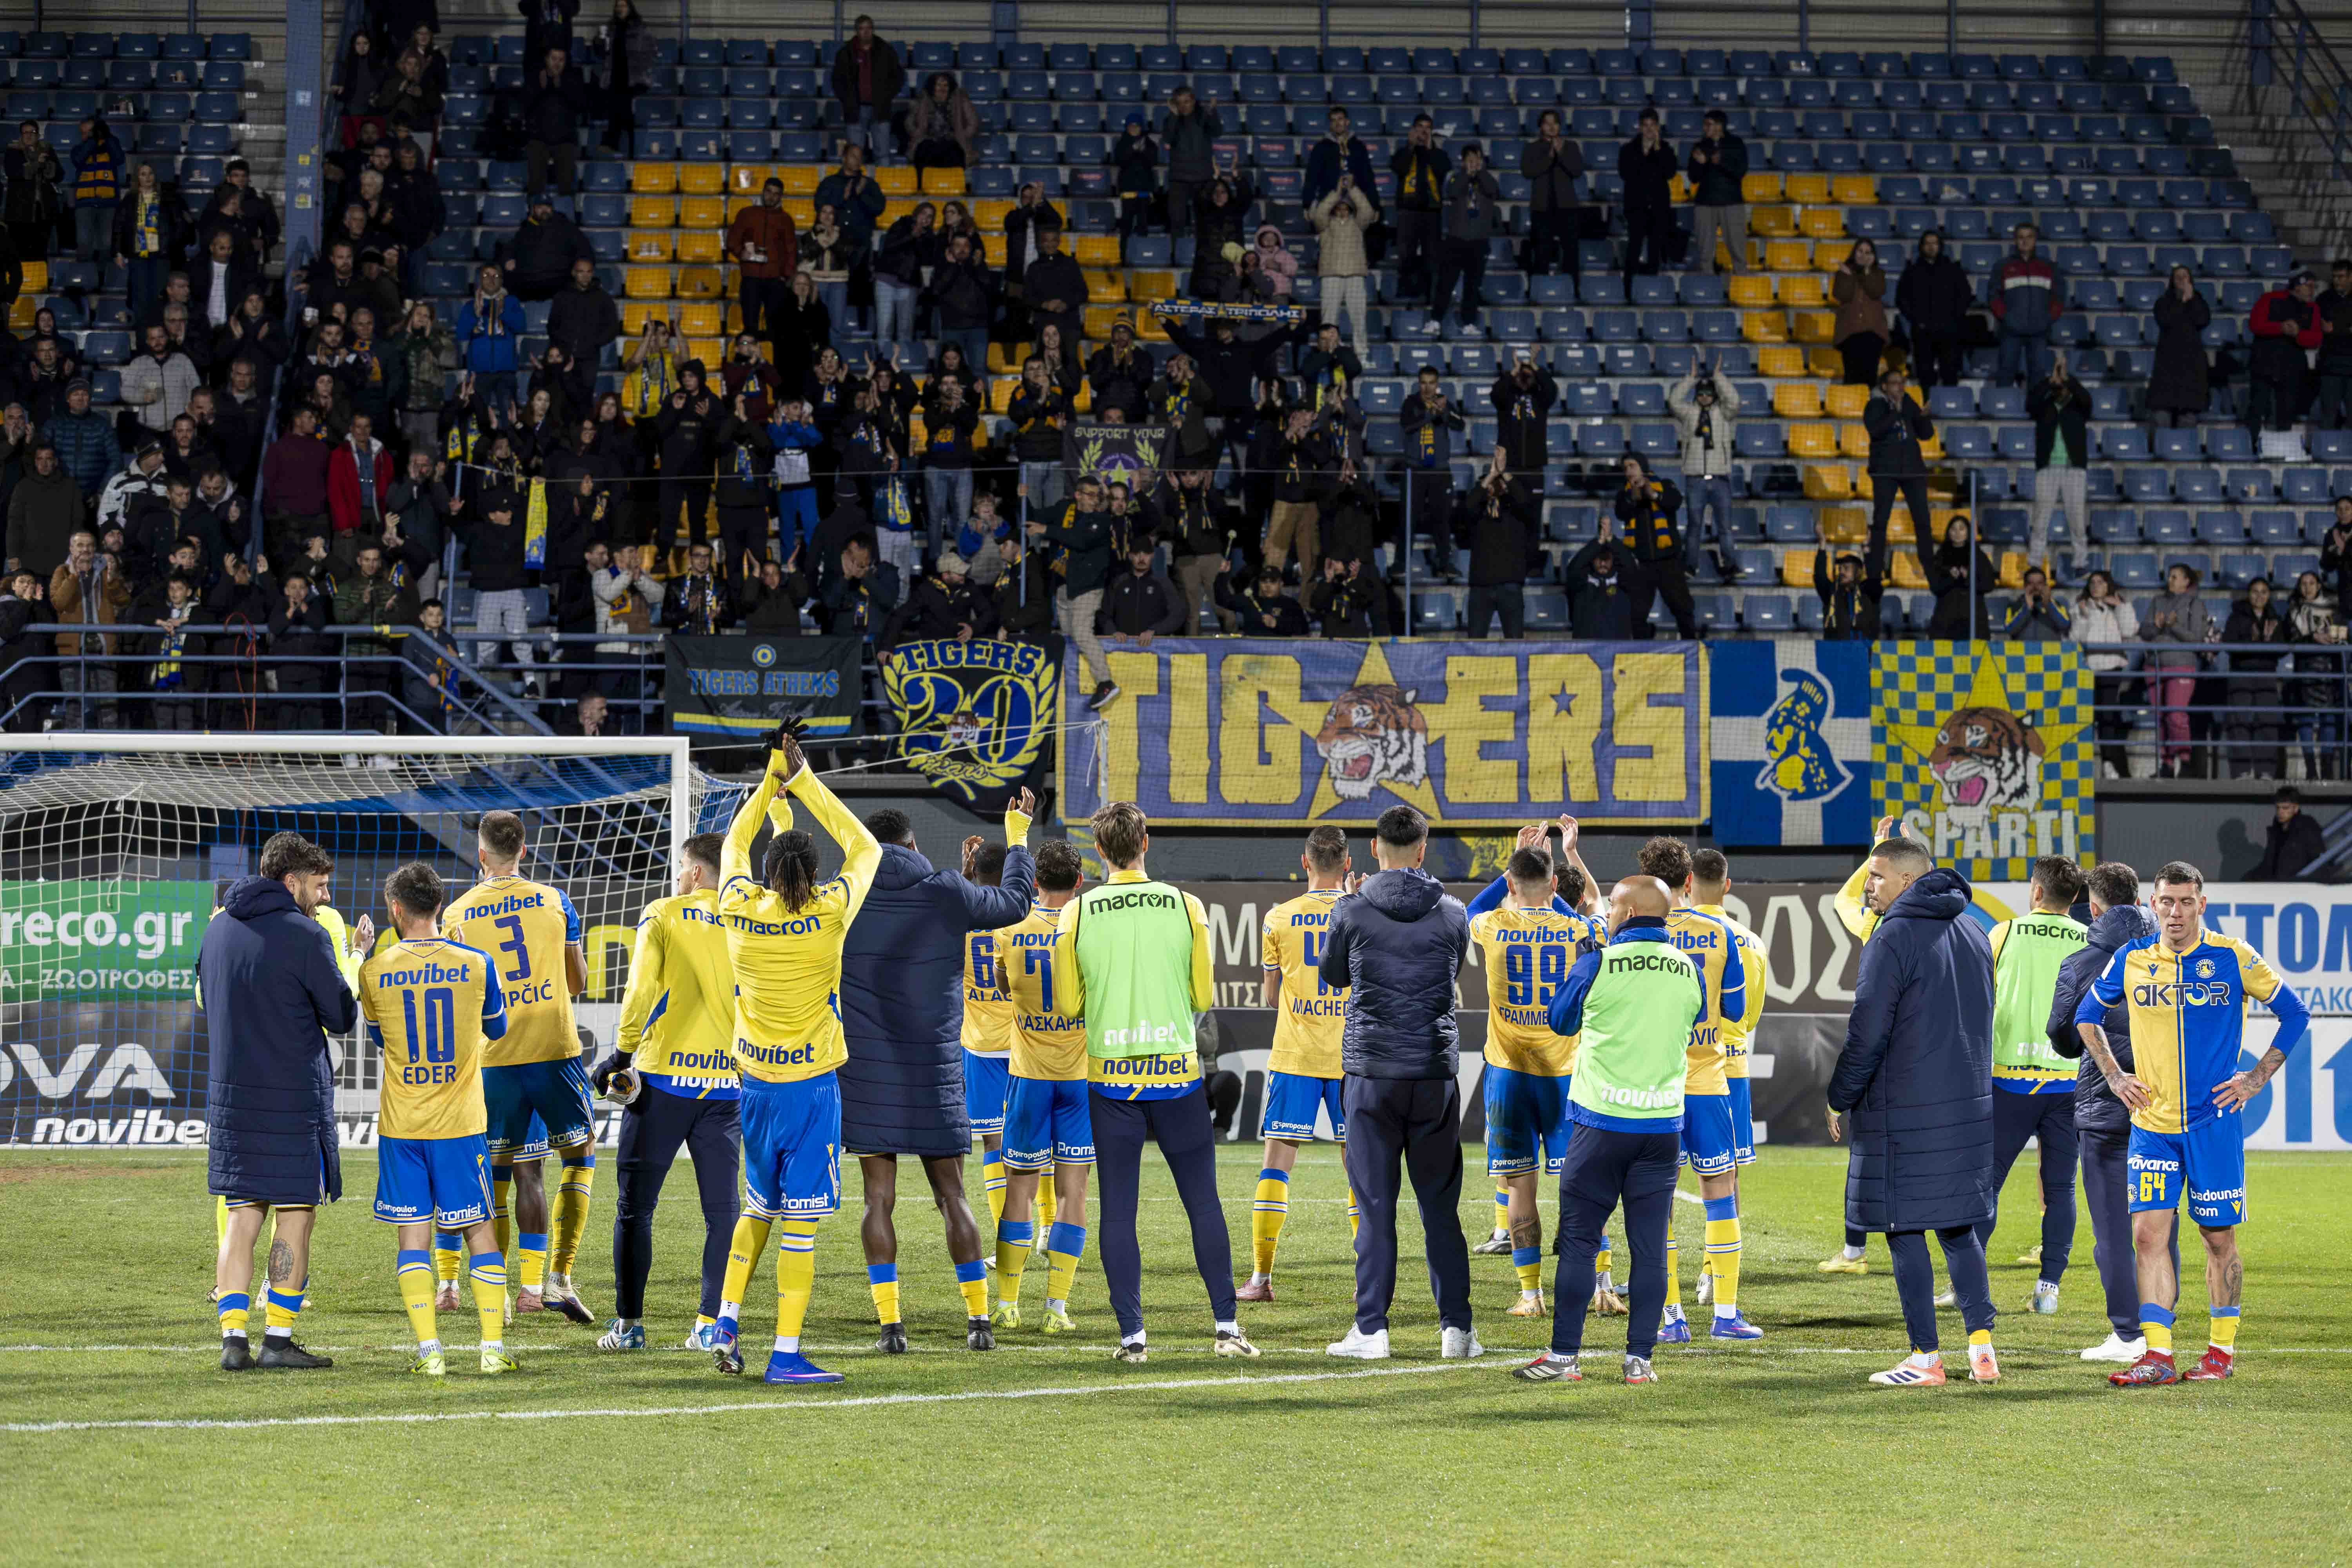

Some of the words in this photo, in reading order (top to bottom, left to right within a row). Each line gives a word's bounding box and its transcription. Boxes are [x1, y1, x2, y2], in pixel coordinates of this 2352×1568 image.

[1074, 427, 1130, 439] SUPPORT
[1134, 428, 1165, 439] YOUR
[894, 639, 1044, 677] TIGERS
[687, 669, 759, 695] TIGERS
[762, 670, 839, 697] ATHENS
[900, 673, 1036, 768] 20
[1078, 651, 1686, 804] TIGERS
[1902, 809, 2077, 860] SPARTI
[464, 893, 545, 921] novibet
[1089, 893, 1176, 916] macron
[733, 915, 822, 936] macron
[1496, 926, 1575, 943] novibet
[494, 914, 531, 982] 3
[379, 963, 470, 988] novibet
[971, 936, 996, 988] 6
[1506, 945, 1566, 1006] 99
[1609, 955, 1690, 978] macron
[42, 969, 193, 990] ΖΩΟΤΡΟΦΕΣ
[1025, 949, 1053, 1012] 7
[499, 978, 554, 1009] IPČIĆ
[402, 987, 455, 1063] 10
[1018, 1014, 1085, 1031] ΛΑΣΚΑΡΗ
[669, 1049, 736, 1071] novibe
[738, 1038, 815, 1065] novibet
[1103, 1054, 1189, 1076] novibet
[403, 1064, 456, 1084] EDER
[32, 1109, 210, 1144] novibe
[1692, 1149, 1730, 1167] Promist
[2140, 1172, 2166, 1201] 64
[2190, 1187, 2243, 1201] badounas
[733, 1254, 748, 1264] 1931
